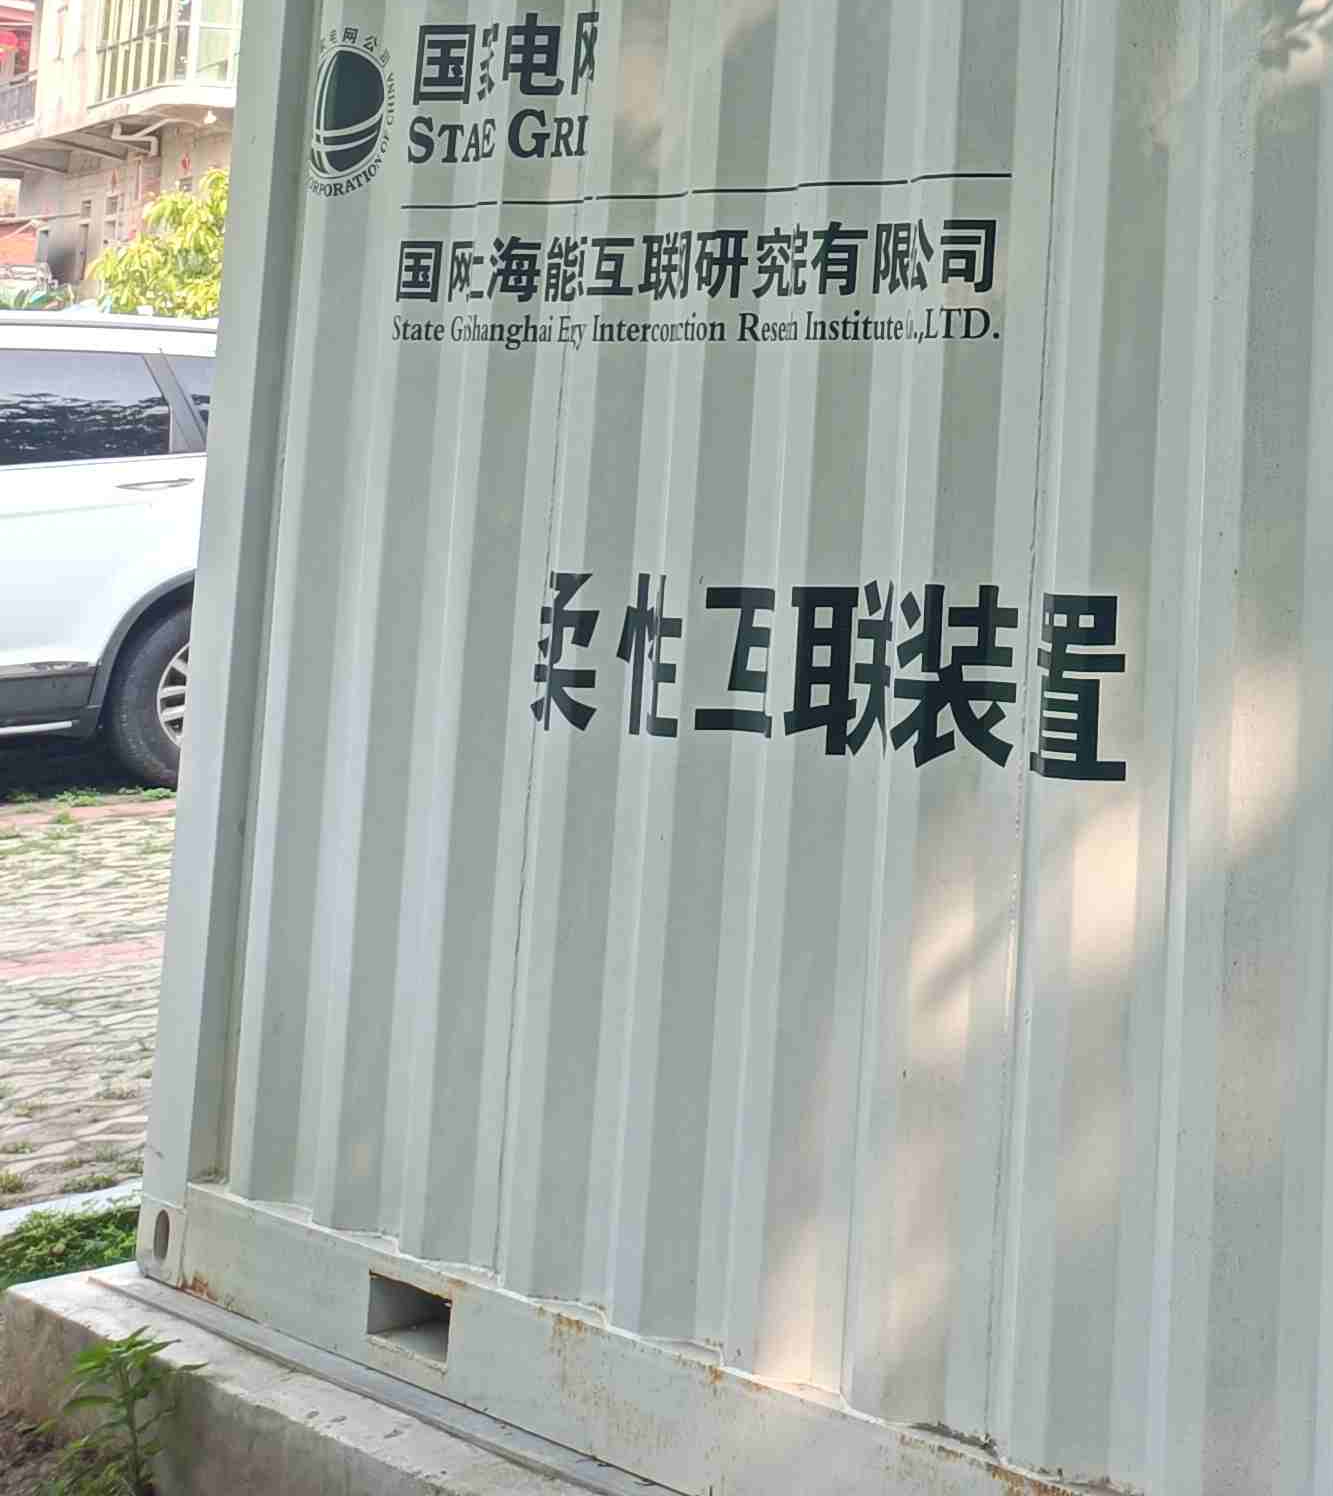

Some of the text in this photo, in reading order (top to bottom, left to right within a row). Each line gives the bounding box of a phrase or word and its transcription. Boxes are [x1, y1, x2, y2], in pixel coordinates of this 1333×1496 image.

[392, 315, 446, 342] State
[804, 309, 905, 342] Institute
[530, 570, 1127, 783] 柔性互联装置
